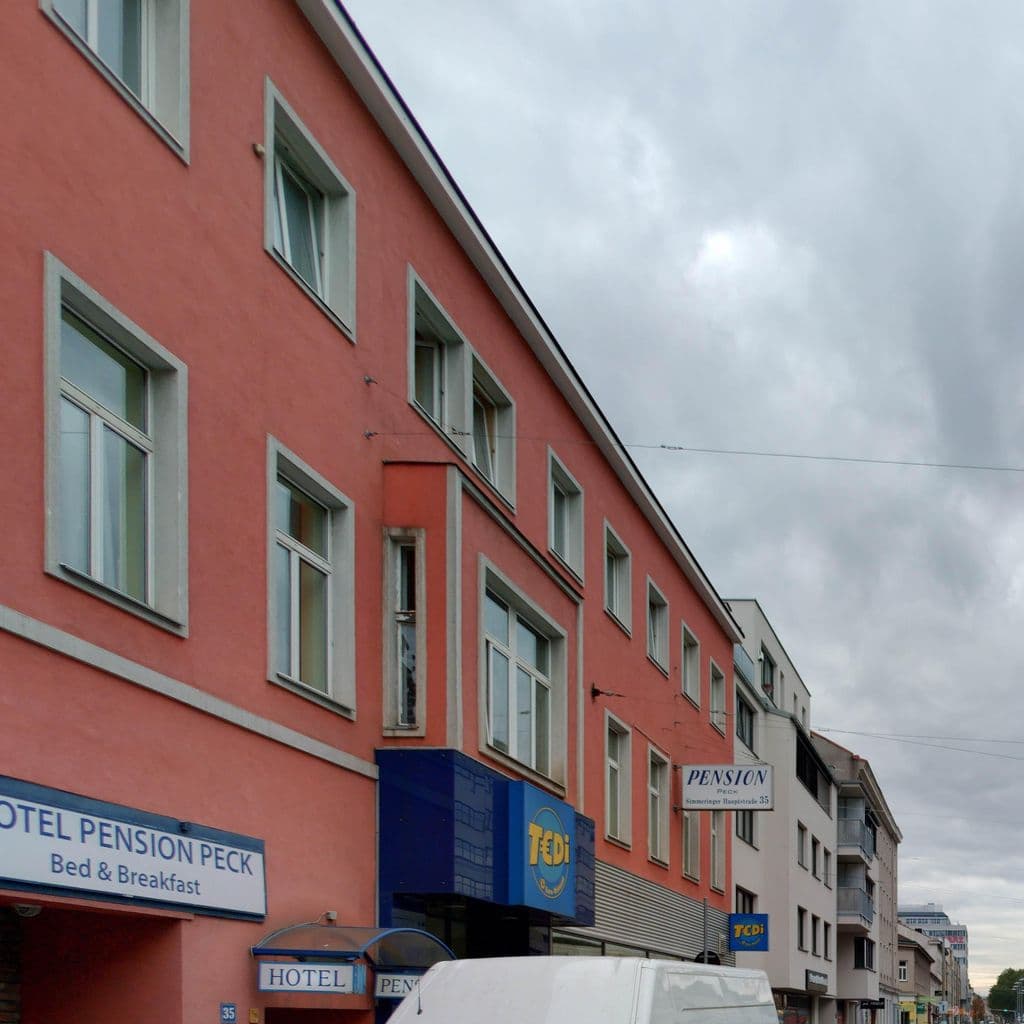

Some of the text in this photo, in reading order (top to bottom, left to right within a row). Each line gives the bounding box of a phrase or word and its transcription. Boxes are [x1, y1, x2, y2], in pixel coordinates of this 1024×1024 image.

[687, 769, 768, 786] PENSION
[759, 795, 770, 805] 35
[80, 817, 194, 865] PENSION
[200, 843, 253, 876] PECK
[51, 853, 201, 896] Bed & Breakfast
[269, 967, 346, 988] HOTEL
[223, 1007, 235, 1020] 35
